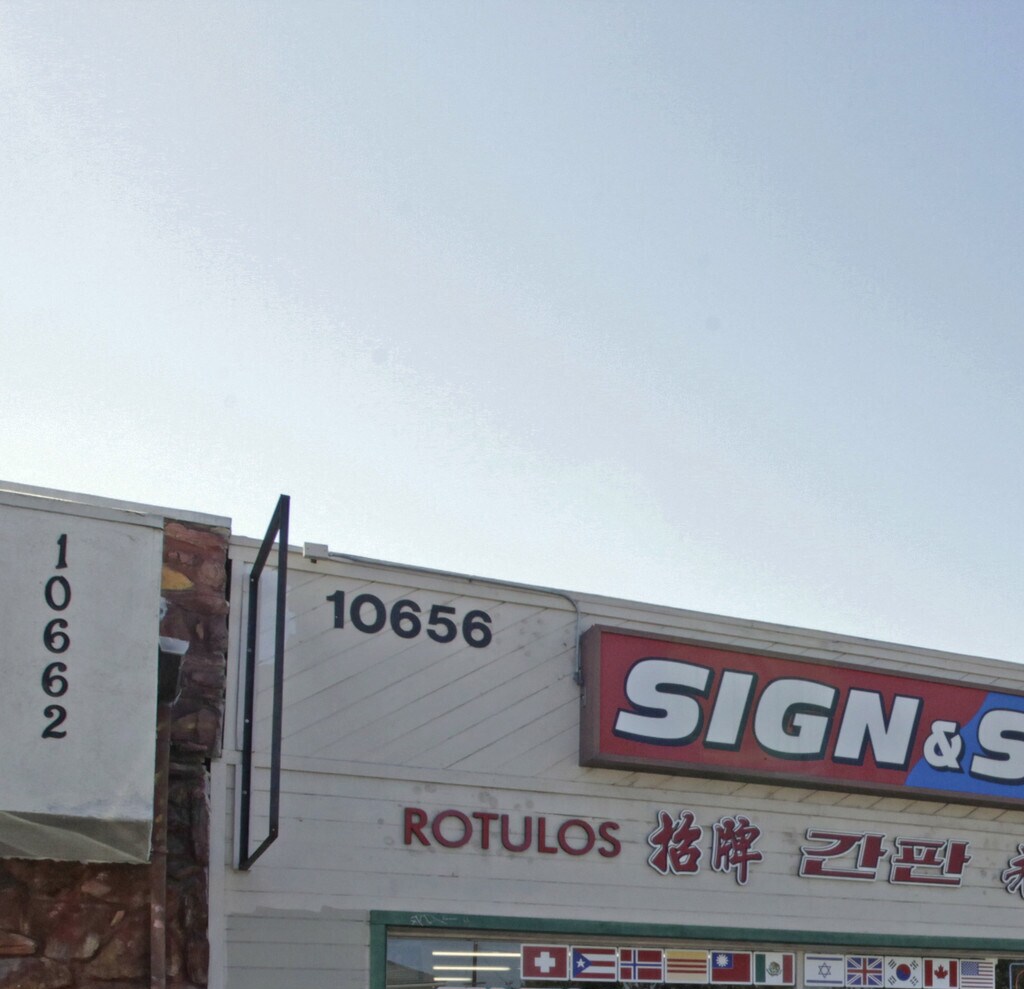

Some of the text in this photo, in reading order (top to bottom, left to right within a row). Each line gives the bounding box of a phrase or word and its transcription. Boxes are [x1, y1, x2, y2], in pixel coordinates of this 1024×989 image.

[42, 533, 72, 739] 10662
[326, 589, 493, 648] 10656
[612, 656, 924, 771] SIGN
[923, 719, 965, 774] &
[404, 806, 622, 858] ROTULOS
[648, 809, 763, 885] 招牌
[799, 828, 971, 888] 간판
